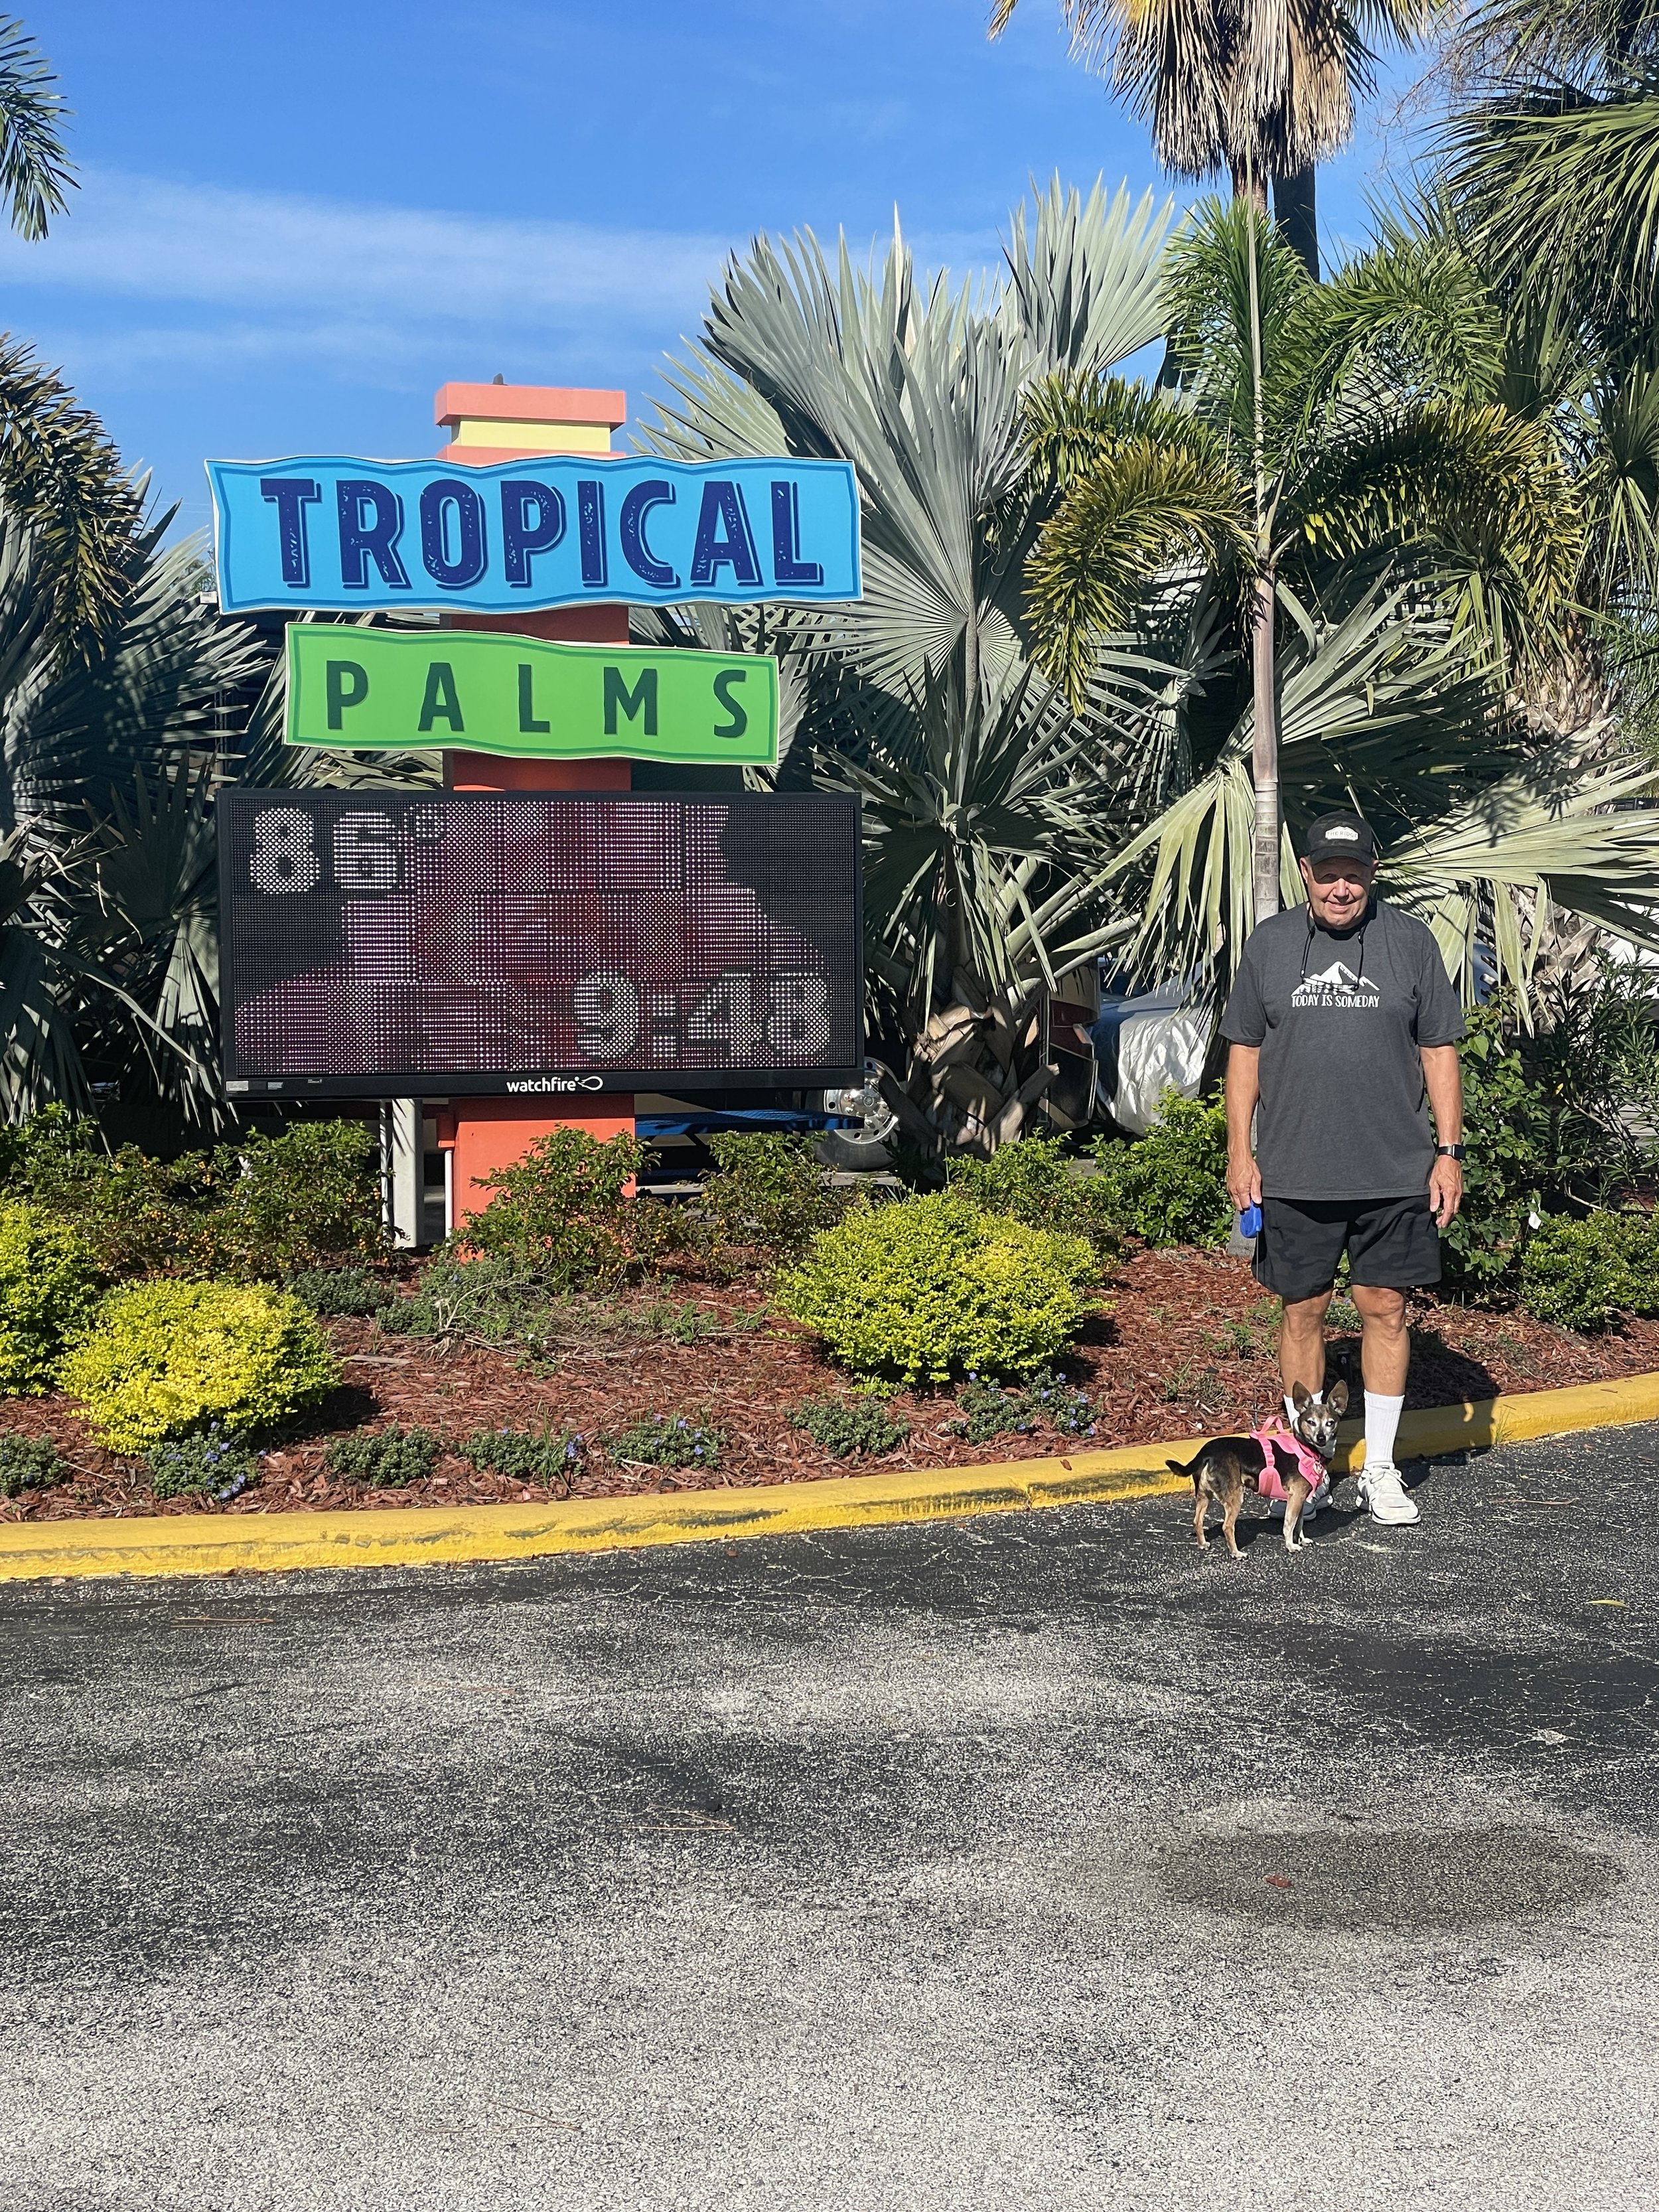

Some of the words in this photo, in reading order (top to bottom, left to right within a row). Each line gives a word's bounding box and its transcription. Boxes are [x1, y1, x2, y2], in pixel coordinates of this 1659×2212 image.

[260, 478, 824, 591] TROPICAL
[326, 660, 749, 739] PALMS
[573, 972, 830, 1058] 9:48
[1291, 995, 1319, 1007] TODAY
[1321, 995, 1333, 1006] IS
[1335, 995, 1380, 1007] SOMEDAY
[506, 1076, 576, 1092] watchfire
